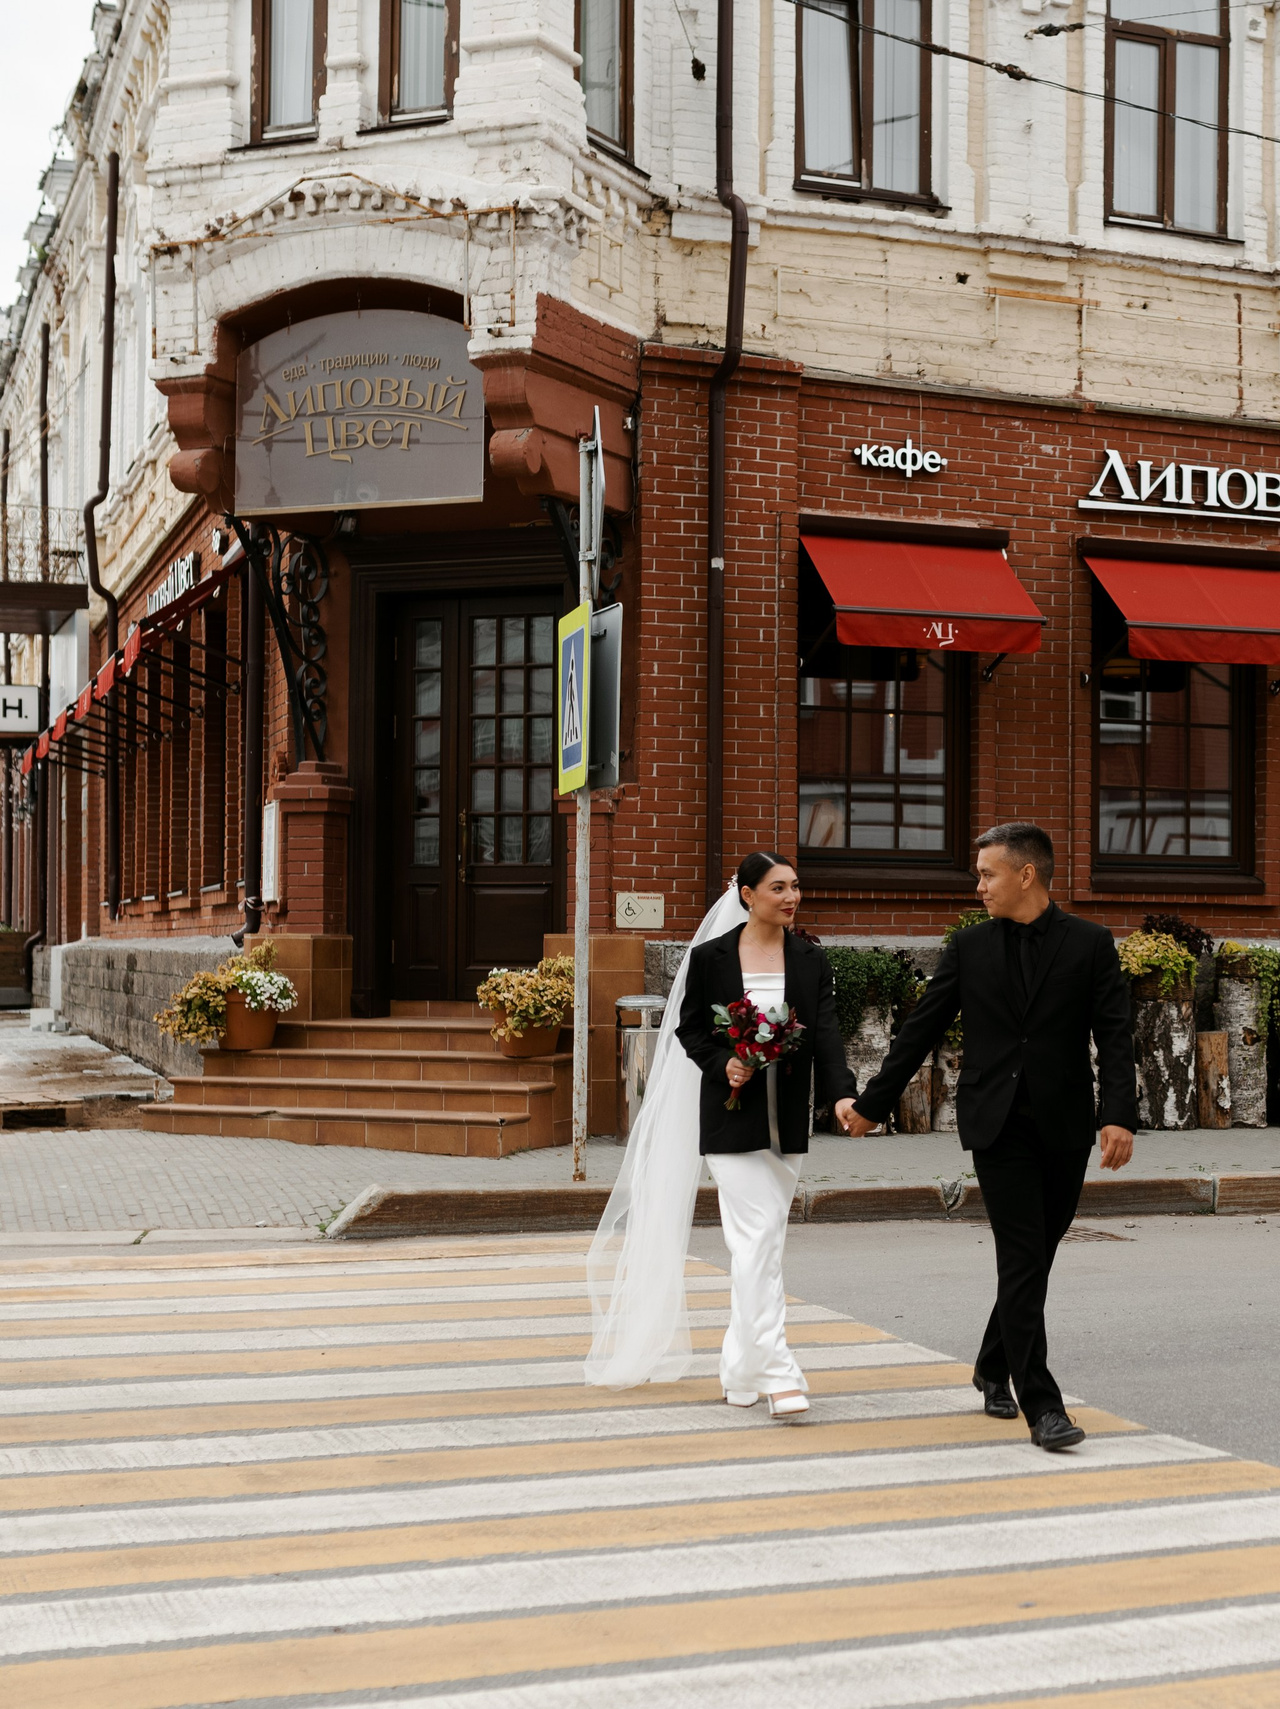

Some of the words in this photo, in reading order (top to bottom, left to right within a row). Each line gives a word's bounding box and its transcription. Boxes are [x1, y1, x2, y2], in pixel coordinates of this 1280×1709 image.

[282, 365, 308, 383] еда
[319, 352, 389, 374] традиции
[401, 353, 441, 370] люди
